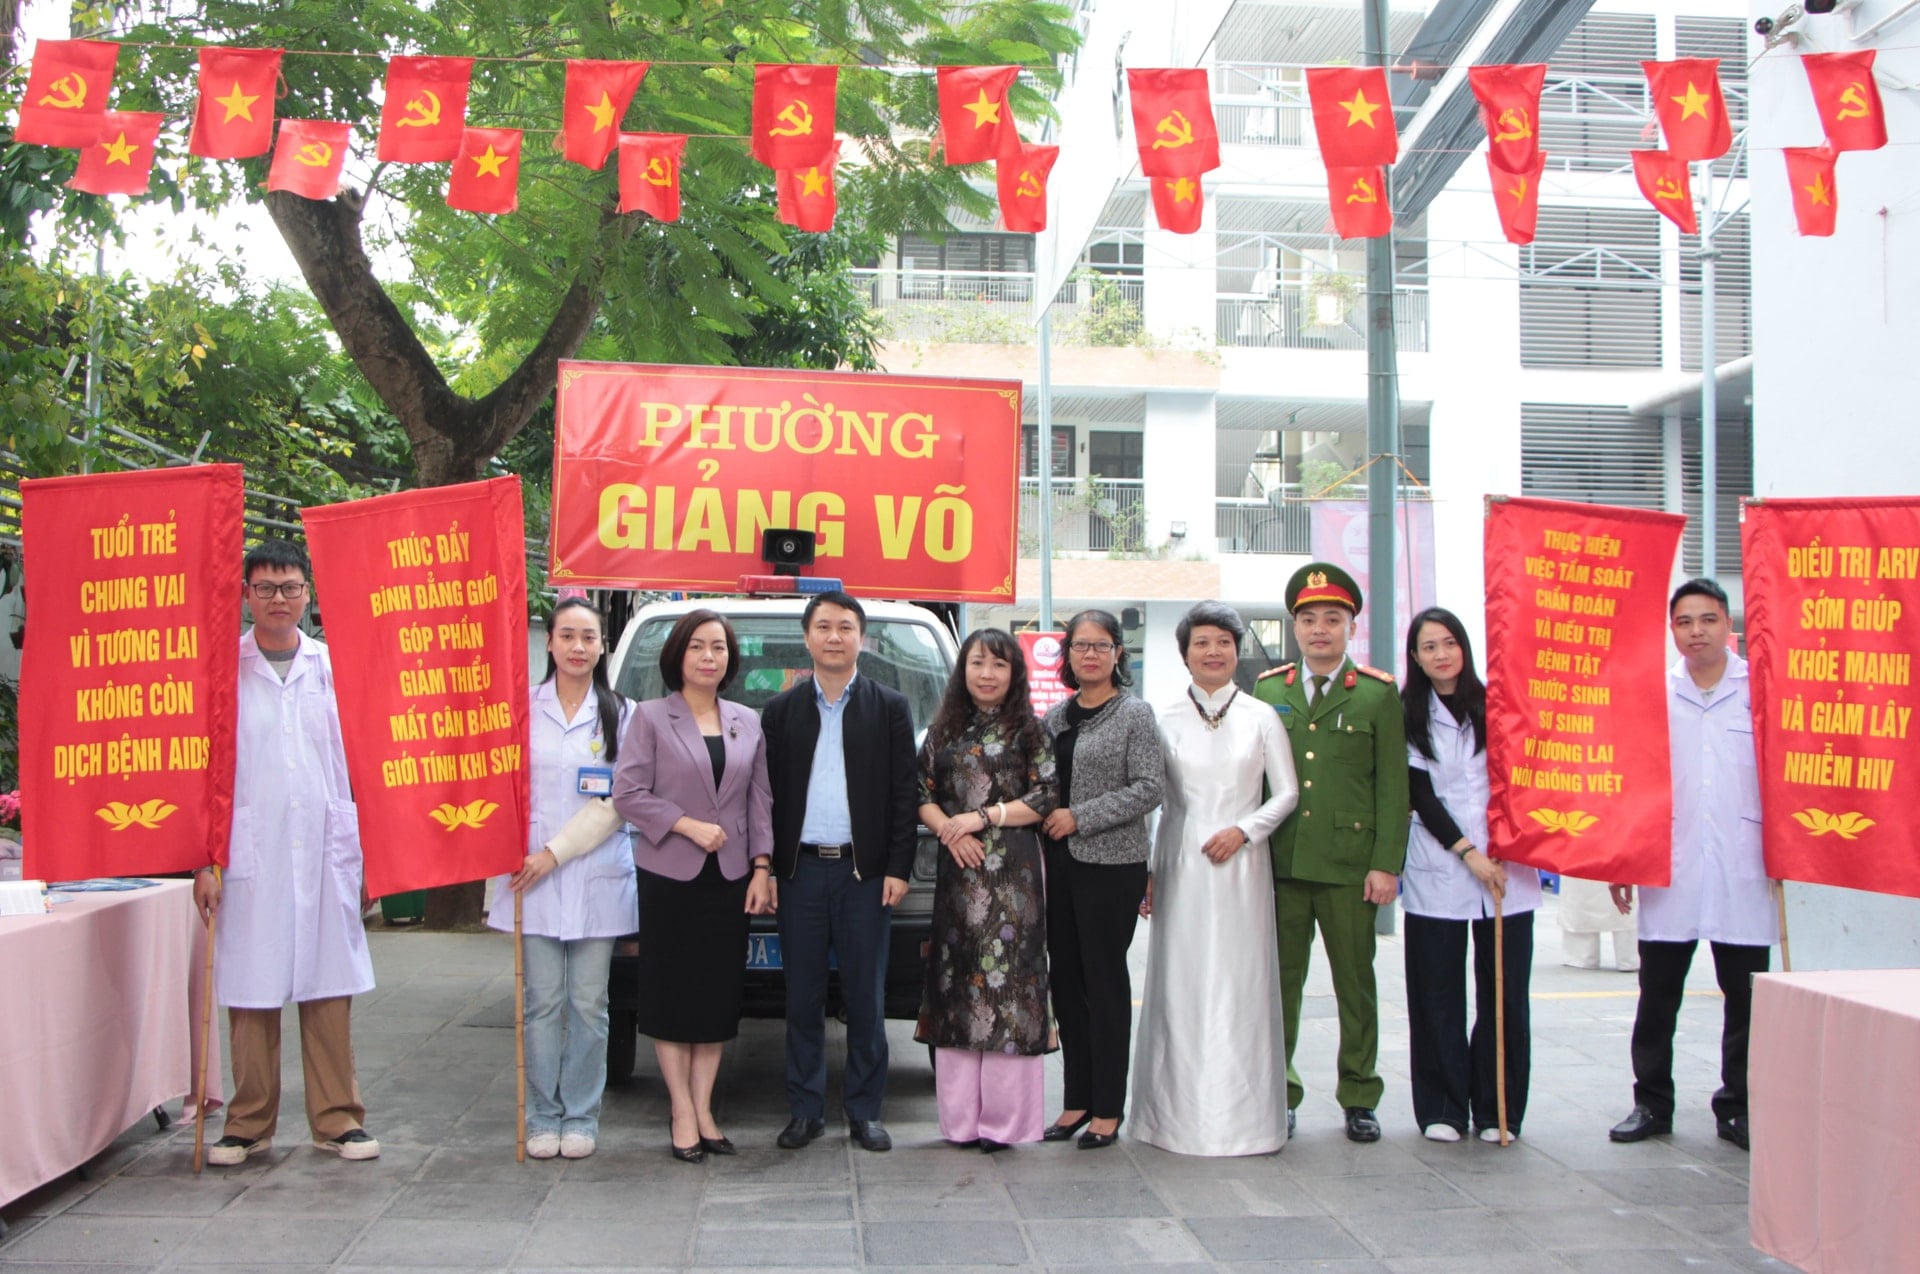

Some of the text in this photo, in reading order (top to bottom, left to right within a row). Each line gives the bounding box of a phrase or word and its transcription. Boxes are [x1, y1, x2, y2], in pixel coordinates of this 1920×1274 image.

[638, 392, 941, 460] PHƯỜNG
[598, 458, 973, 564] GIẢNG VÕ
[91, 509, 177, 559] TUỔI TRẺ
[387, 520, 470, 569] THÚC ĐẨY
[1544, 529, 1621, 560] THỰC HIỆN
[1524, 554, 1556, 582] VIỆC
[1593, 566, 1634, 590] SOÁT
[1787, 535, 1920, 586] ĐIỀU TRỊ ARV
[81, 573, 185, 613] CHUNG VAI
[370, 570, 498, 618] BÌNH ĐẲNG GIỚI
[1572, 593, 1616, 617] ĐOÁN
[1800, 588, 1902, 632] SỚM GIÚP
[70, 626, 198, 668] VÌ TƯƠNG LAI
[399, 613, 484, 653] GÓP PHẦN
[1535, 616, 1551, 640] VÀ
[1588, 625, 1612, 651] TRỊ
[399, 654, 491, 697] GIẢM THIỂU
[1536, 647, 1601, 679] BỆNH TẬT
[1787, 636, 1911, 691] KHỎE MẠNH
[76, 673, 194, 722] KHÔNG CÒN
[1528, 677, 1611, 706] TRƯỚC SINH
[389, 696, 512, 742] MẤT CÂN BẰNG
[1539, 709, 1595, 735] SƠ SINH
[1781, 689, 1912, 739] VÀ GIẢM LÂY
[54, 733, 210, 785] DỊCH BỆNH AIDS
[382, 750, 419, 788] GIỚI
[420, 750, 458, 784] TÍNH
[459, 751, 488, 781] KHI
[1524, 733, 1615, 764] VÌ TƯƠNG LAI
[1784, 741, 1895, 791] NHIỄM HIV
[1511, 763, 1624, 797] NÒI GIỐNG VIỆT
